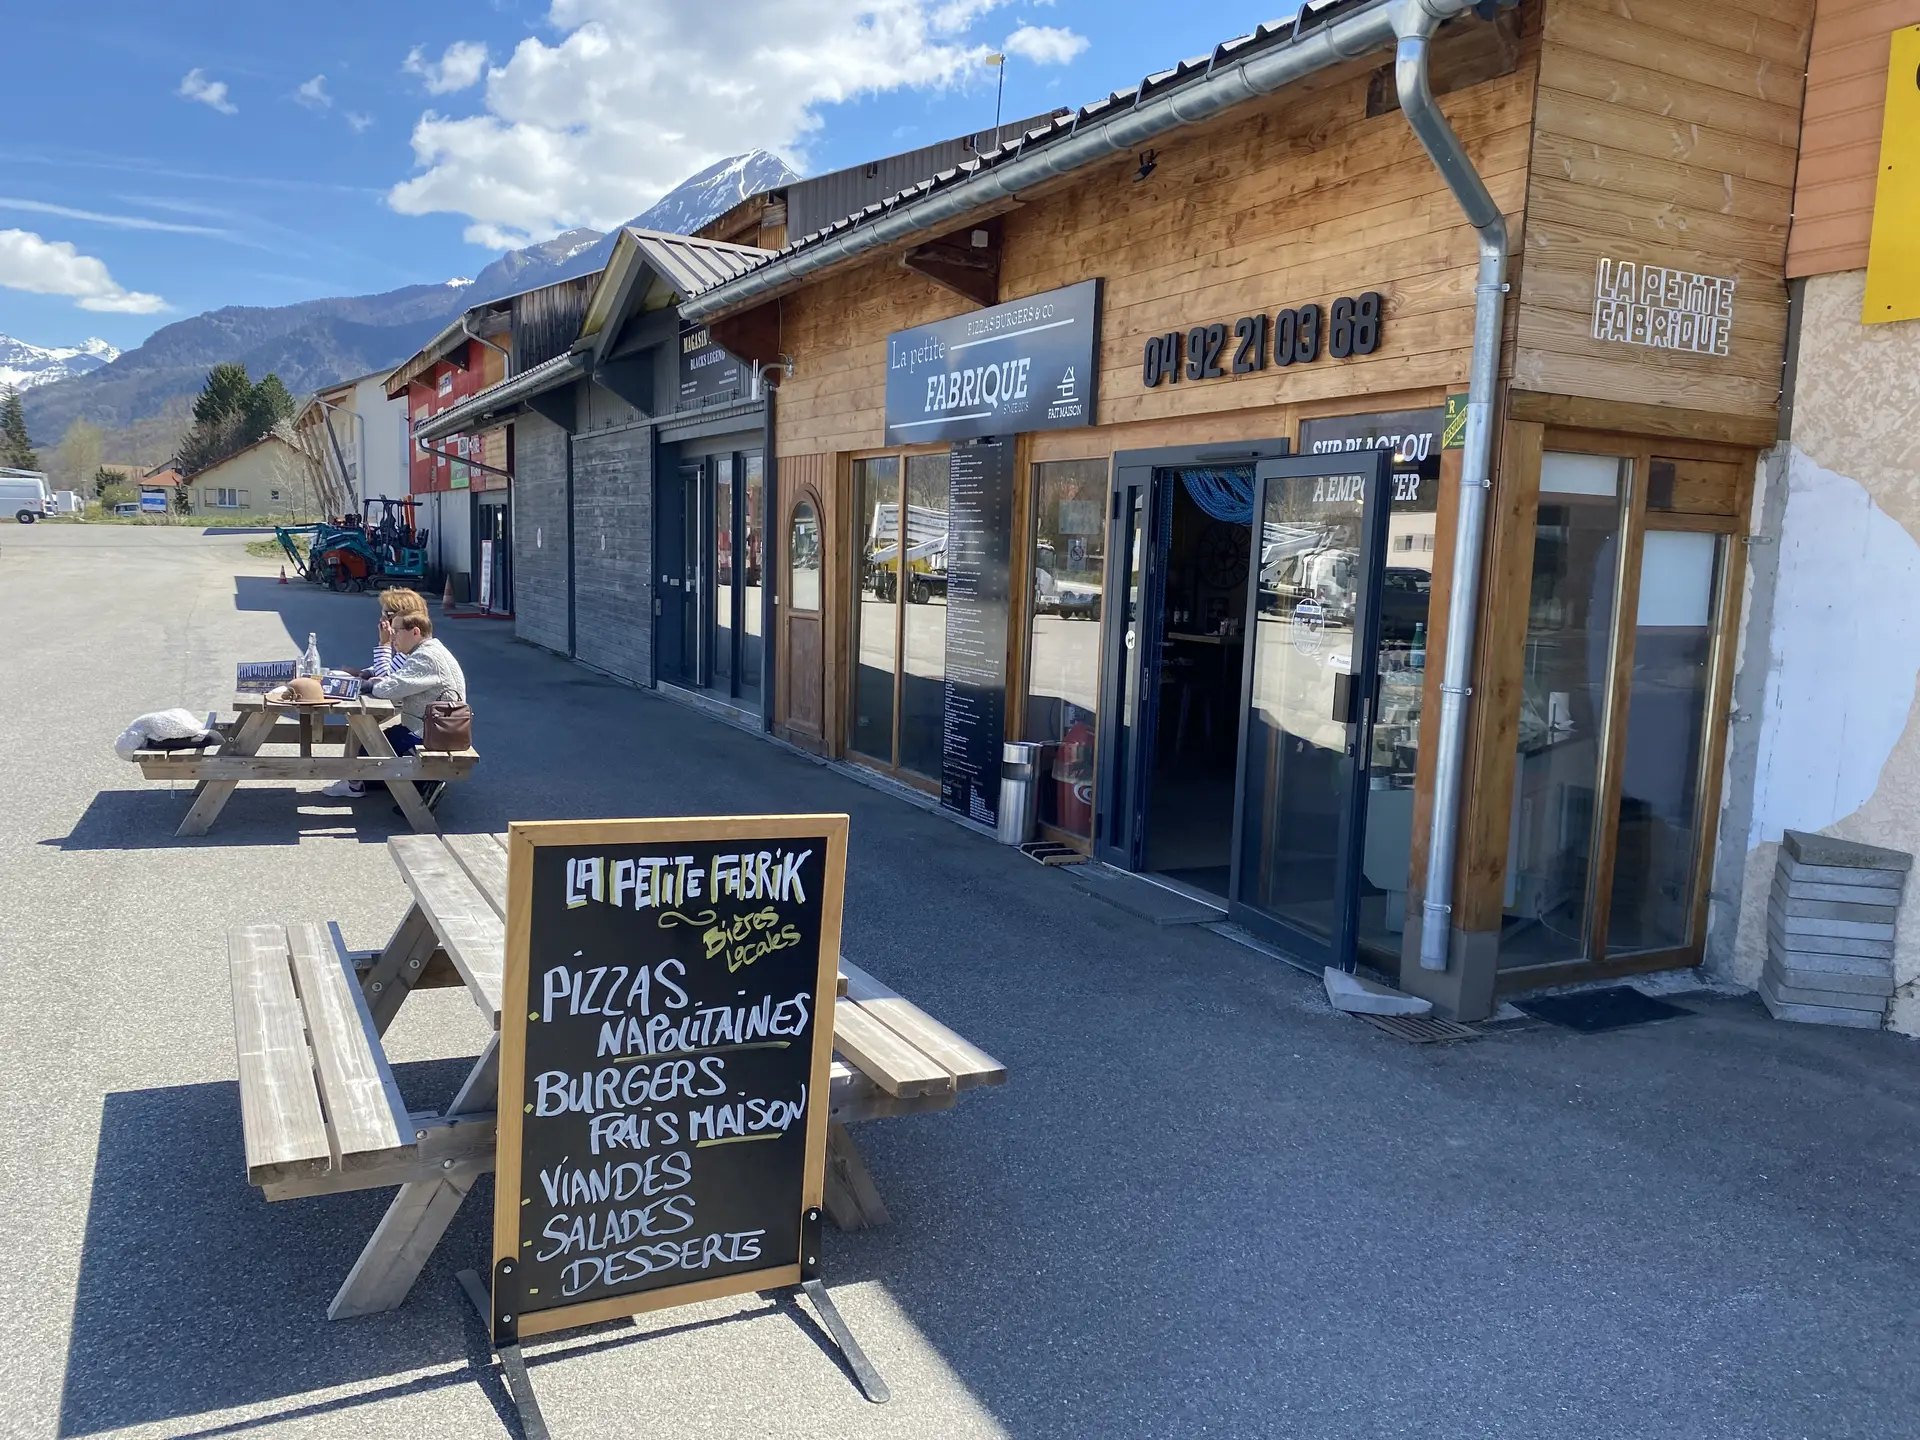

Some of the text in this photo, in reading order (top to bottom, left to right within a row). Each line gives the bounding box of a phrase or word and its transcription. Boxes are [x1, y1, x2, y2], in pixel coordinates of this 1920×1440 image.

[1597, 257, 1636, 303] LA
[995, 306, 1034, 329] BURGERS
[1042, 304, 1054, 317] CO
[1143, 291, 1381, 388] 04 92 21 03 68
[892, 336, 946, 374] La petite
[924, 357, 1031, 412] FABRIQUE
[1402, 433, 1432, 462] OU
[1313, 477, 1324, 502] A
[566, 857, 604, 909] LA
[609, 855, 705, 910] PETITE
[543, 951, 688, 1022] PIZZAS
[534, 1056, 727, 1117] BURGERS
[589, 1084, 806, 1154] FRAIS MAISON
[539, 1151, 692, 1207] VIANDES
[537, 1194, 696, 1263] SALADES
[560, 1229, 766, 1296] DESSERTS
